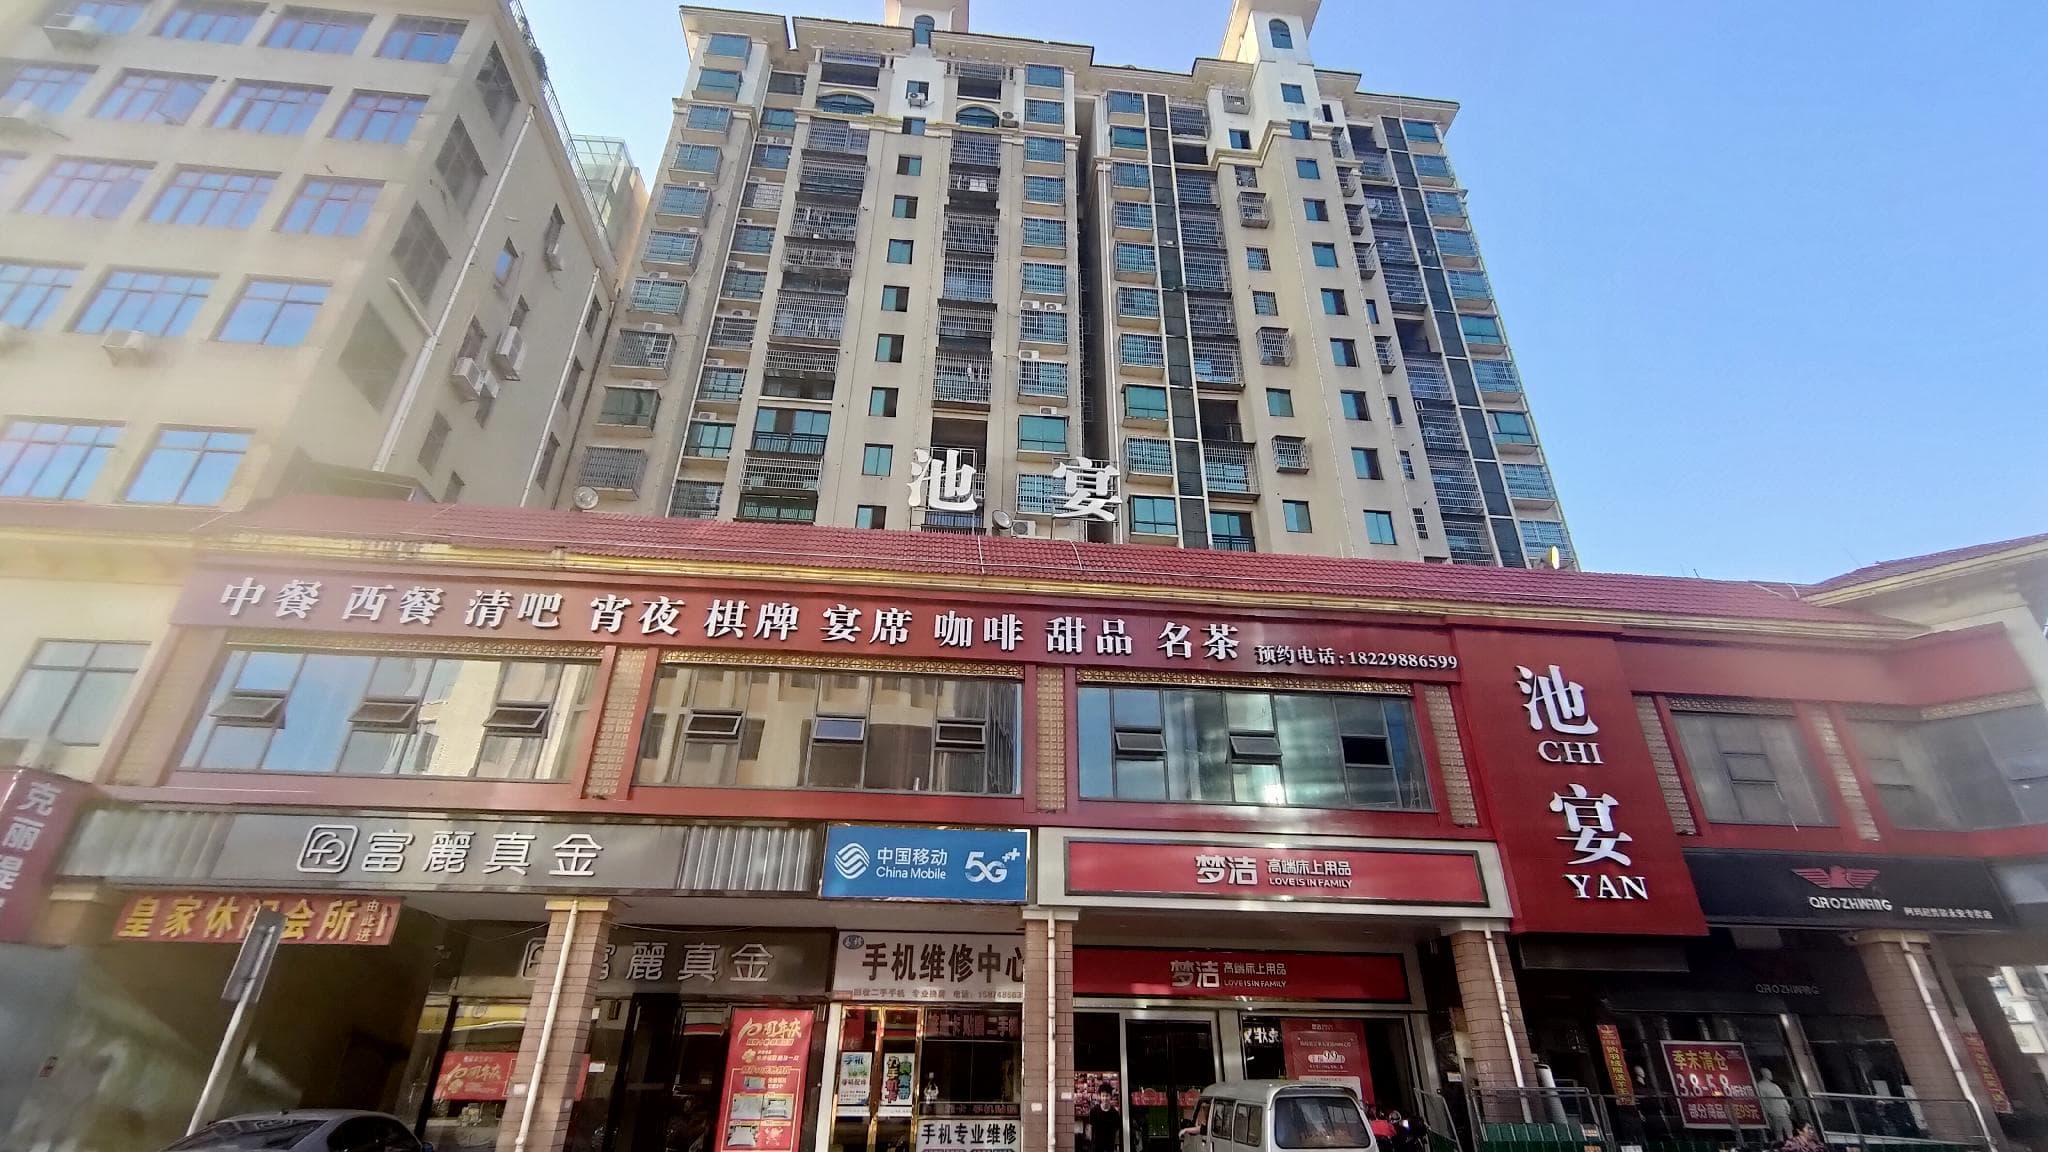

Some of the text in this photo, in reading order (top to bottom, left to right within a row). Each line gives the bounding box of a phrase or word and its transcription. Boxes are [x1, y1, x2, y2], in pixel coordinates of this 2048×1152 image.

[220, 577, 322, 618] 中餐
[341, 584, 444, 625] 西餐
[463, 589, 563, 628] 清吧
[590, 595, 687, 636] 宵夜
[703, 599, 800, 641] 棋牌
[820, 606, 912, 645] 宴席
[933, 610, 1024, 652] 咖啡
[1045, 616, 1133, 656] 甜品
[1156, 621, 1241, 661] 名茶
[1514, 664, 1599, 735] 池
[1538, 740, 1604, 764] CHI
[1550, 783, 1633, 866] 宴
[361, 829, 604, 876] 富麗真金
[877, 847, 947, 866] 中国移动
[876, 866, 947, 880] China Mobile
[1195, 854, 1258, 885] 梦洁
[1267, 859, 1352, 876] 高端床上用品
[1564, 874, 1649, 900] YAN
[862, 942, 1024, 983] 手机维修中心
[1170, 960, 1220, 988] 梦洁
[1672, 1050, 1729, 1071] 季末清仓
[921, 1123, 1017, 1144] 手机专业维修
